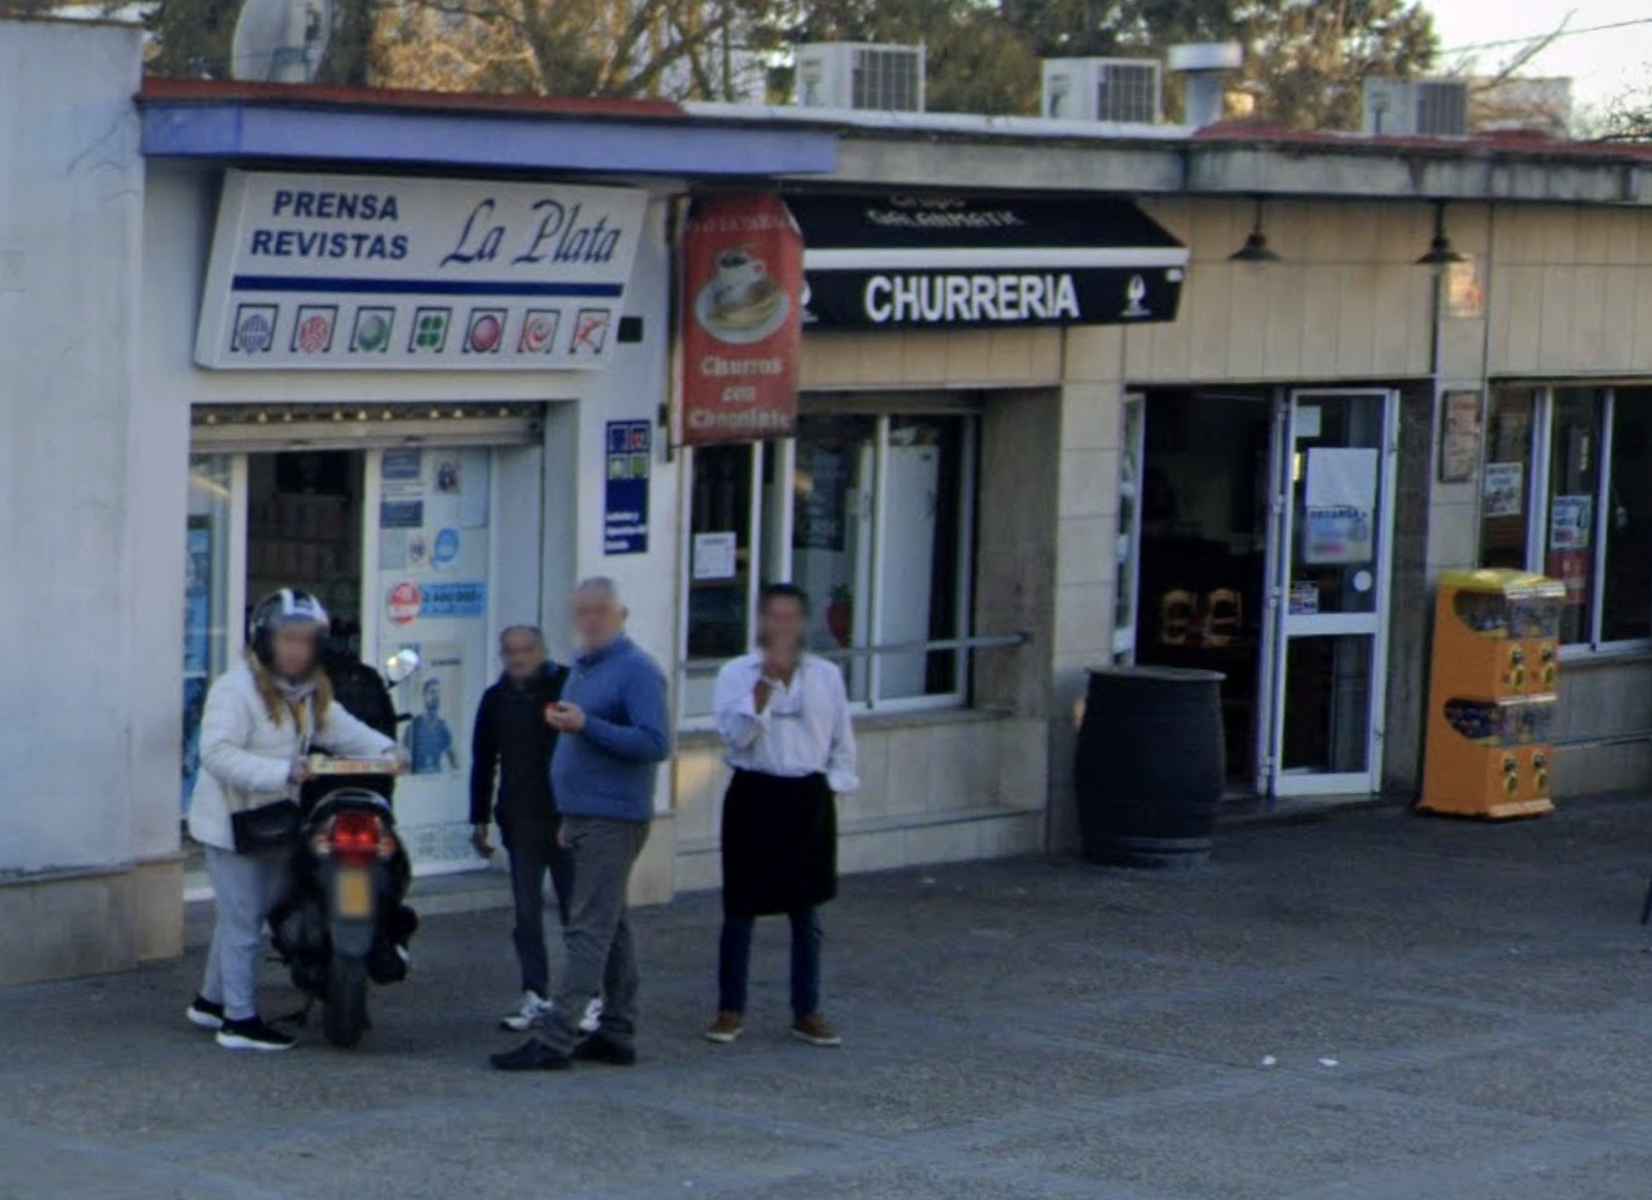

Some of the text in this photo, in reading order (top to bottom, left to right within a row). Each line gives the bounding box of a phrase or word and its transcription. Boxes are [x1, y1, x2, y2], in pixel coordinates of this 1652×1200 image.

[272, 190, 399, 221] PRENSA
[251, 230, 409, 260] REVISTAS
[440, 197, 622, 268] La Plata
[864, 274, 1080, 322] CHURRERIA
